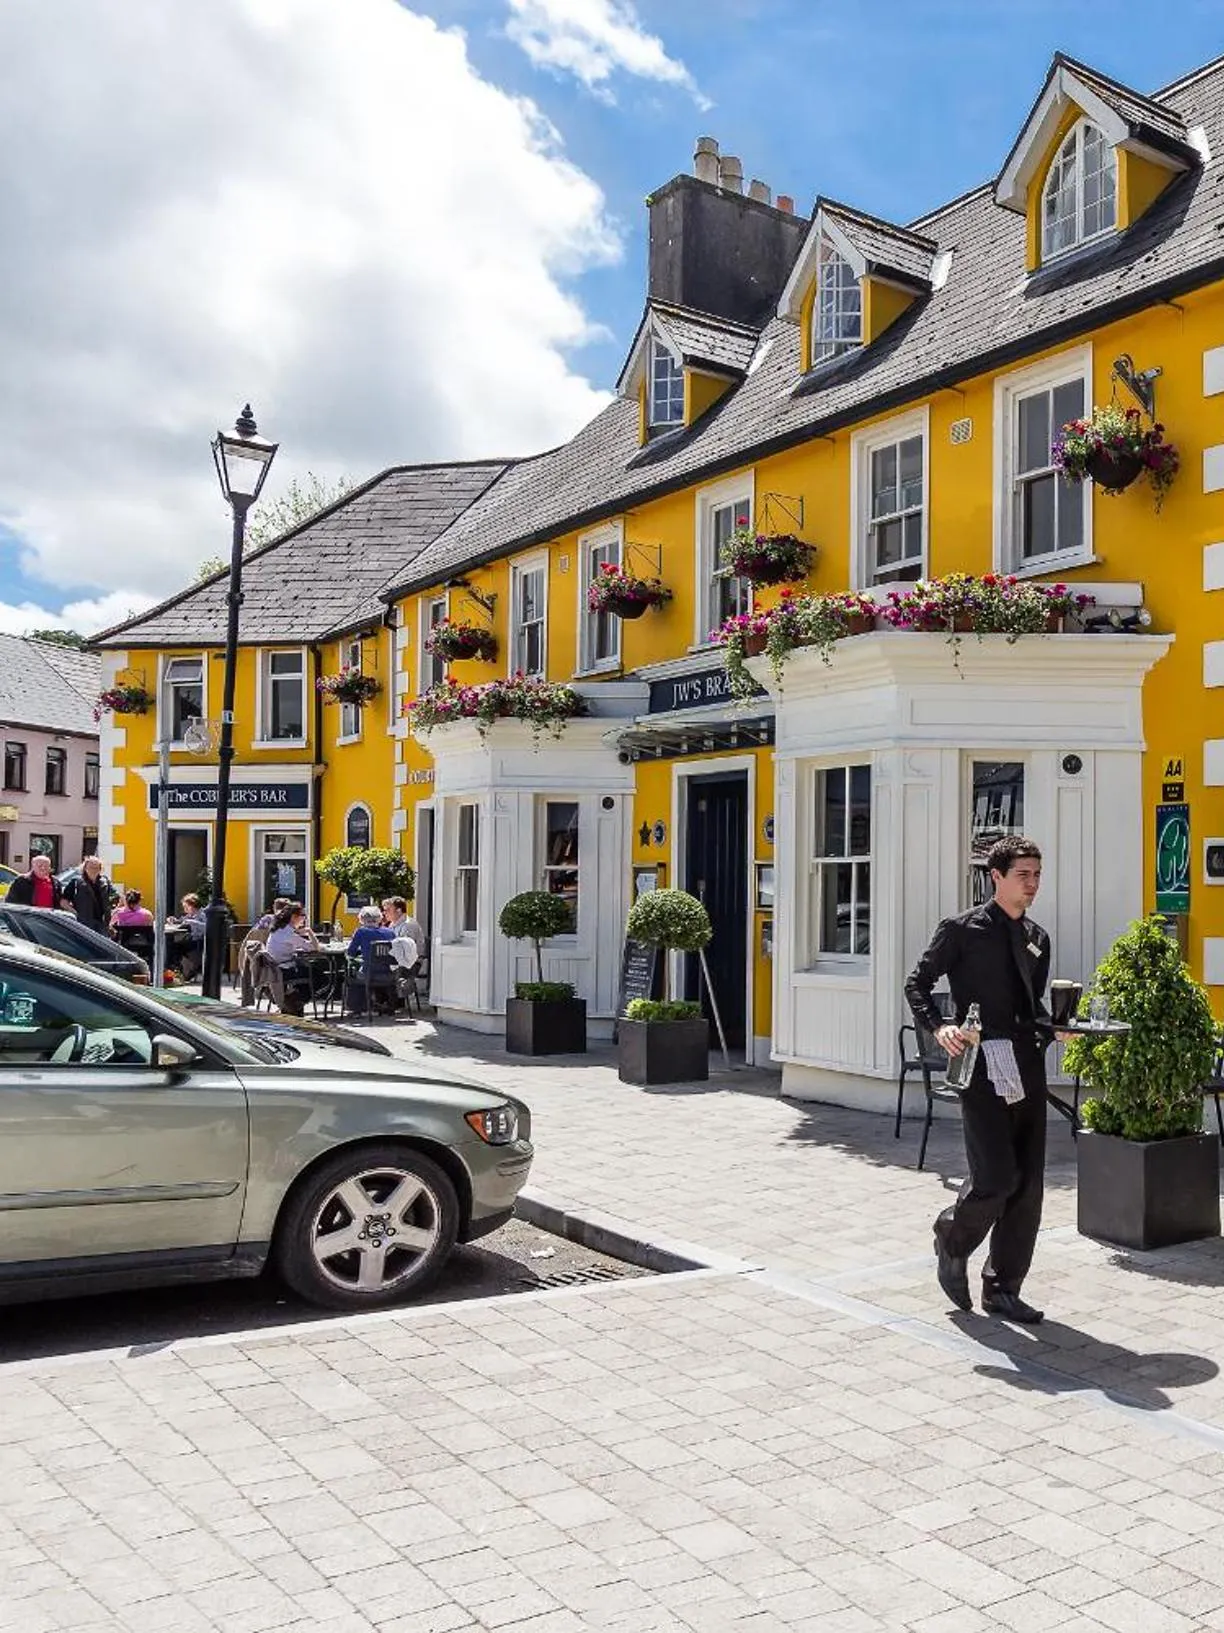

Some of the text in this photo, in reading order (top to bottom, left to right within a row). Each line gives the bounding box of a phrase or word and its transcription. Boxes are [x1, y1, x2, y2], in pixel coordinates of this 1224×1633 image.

[672, 680, 702, 708] JW'S
[1165, 759, 1182, 777] AA
[166, 789, 287, 803] The COBER'S BAR
